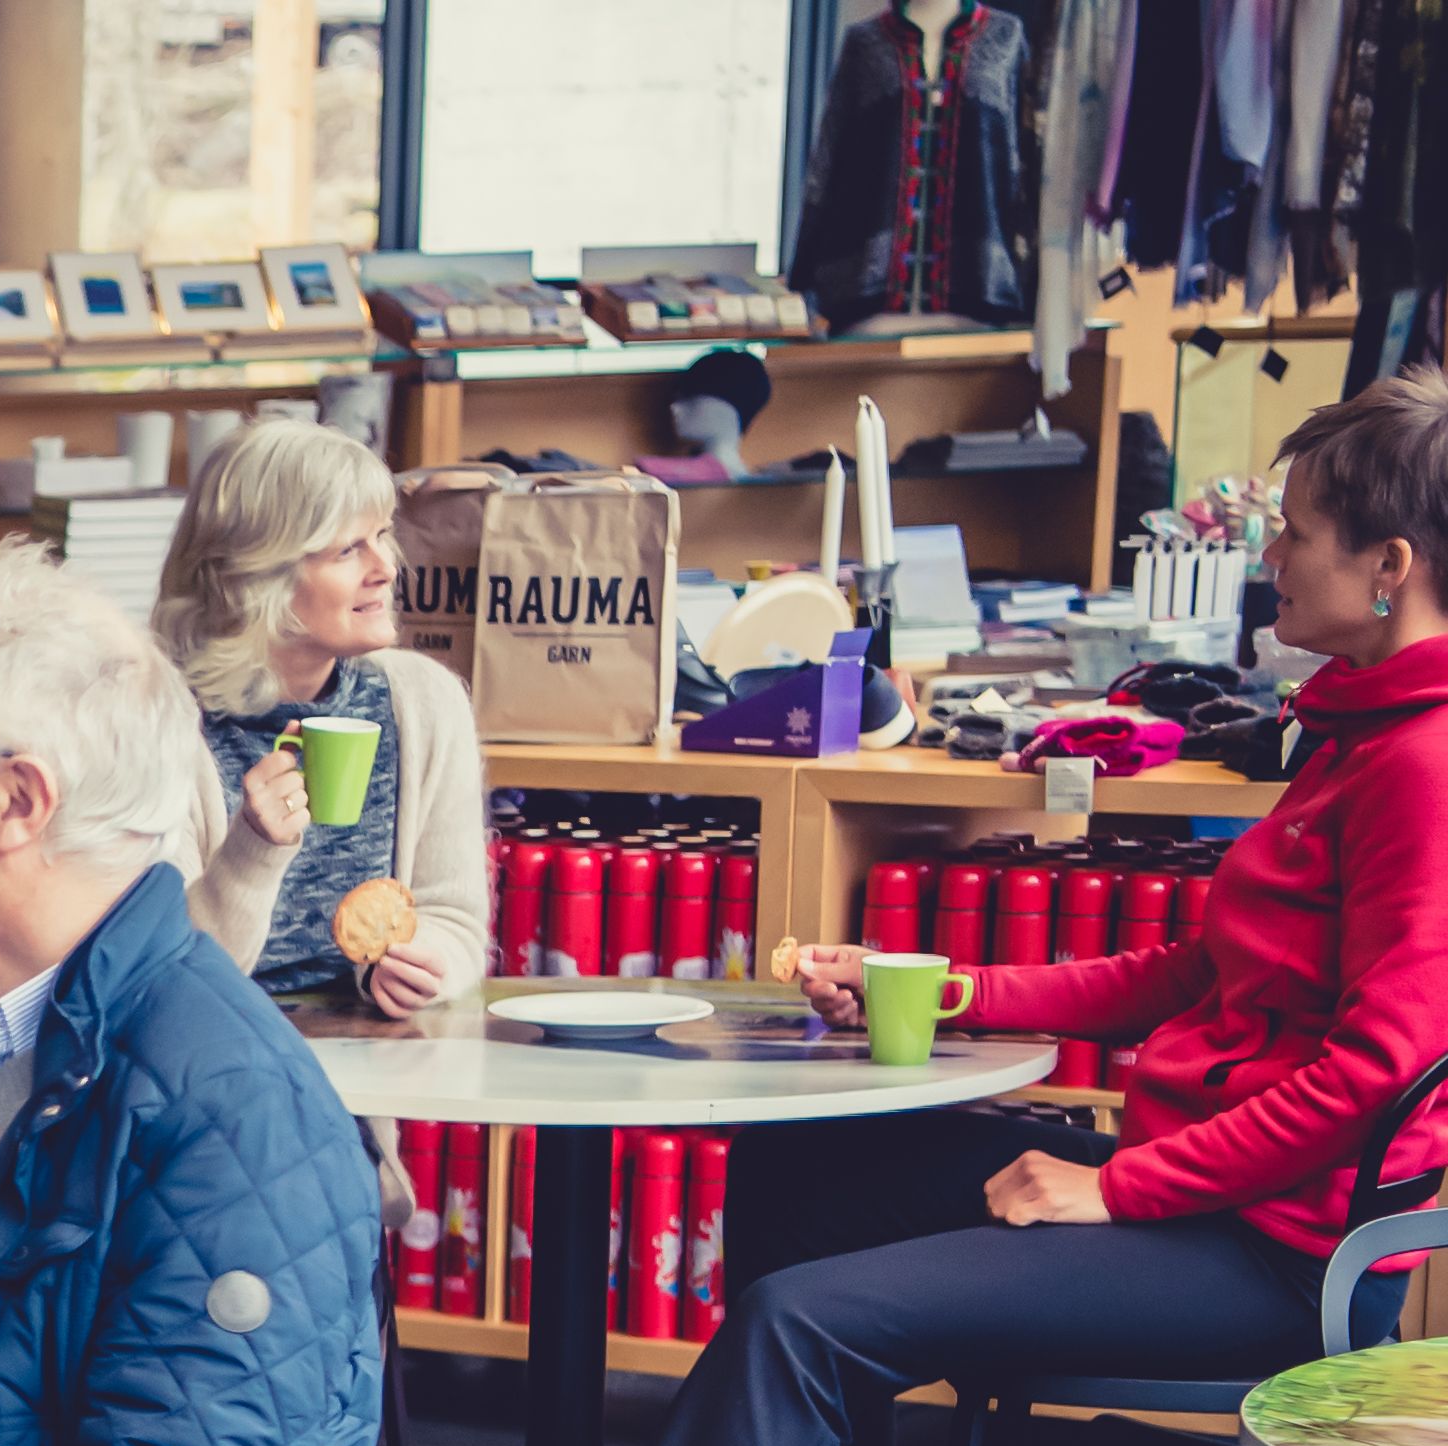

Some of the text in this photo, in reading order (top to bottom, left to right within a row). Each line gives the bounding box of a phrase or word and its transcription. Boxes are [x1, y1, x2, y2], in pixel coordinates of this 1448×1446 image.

[394, 566, 477, 614] AUM
[486, 575, 655, 625] RAUMA
[547, 645, 592, 665] GARN
